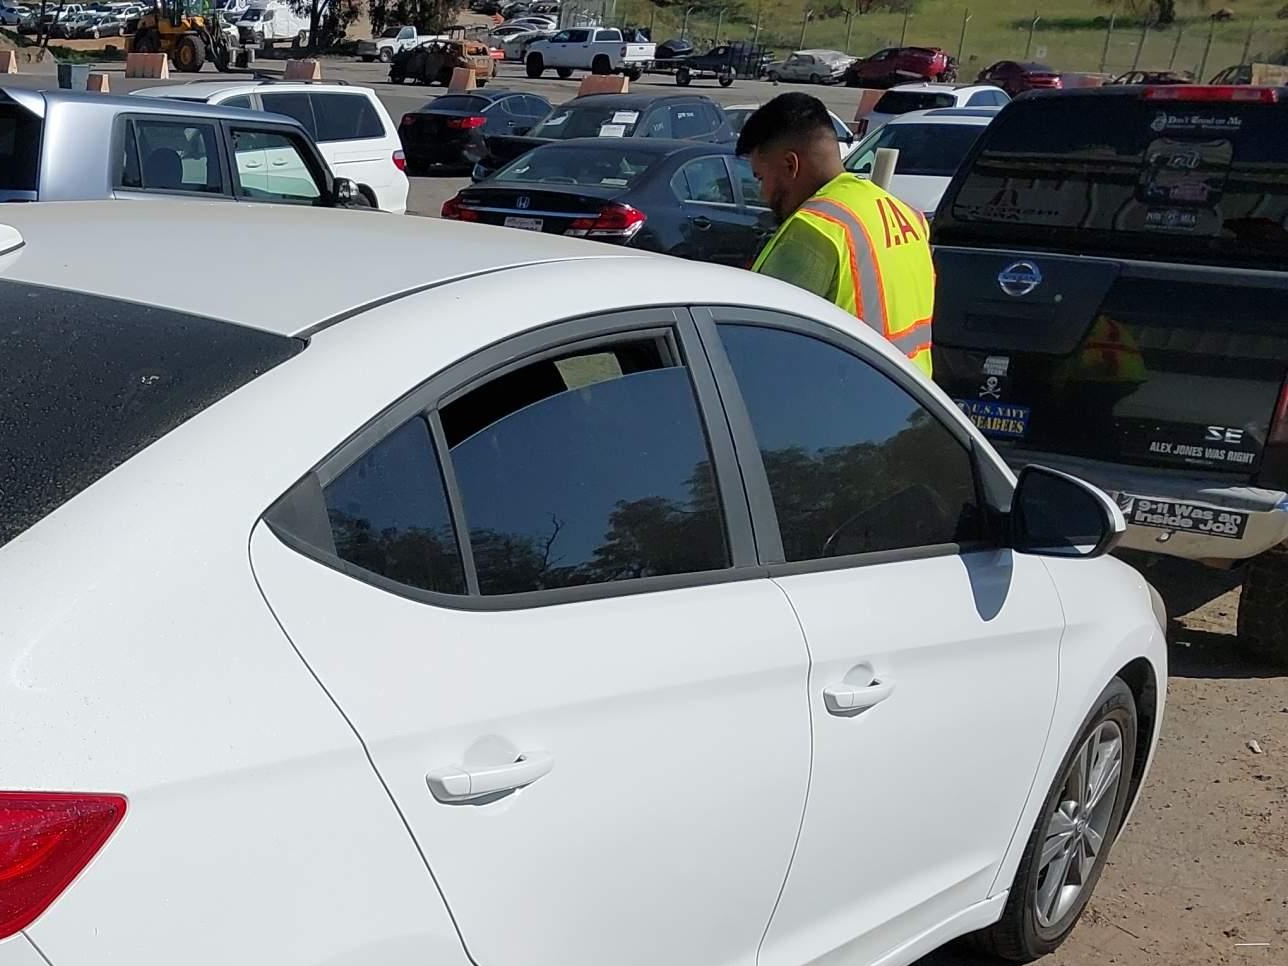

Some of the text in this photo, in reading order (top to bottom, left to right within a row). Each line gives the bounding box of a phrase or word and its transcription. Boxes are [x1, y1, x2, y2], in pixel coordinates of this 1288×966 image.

[996, 407, 1025, 419] NAVY
[970, 415, 1025, 434] SEABEES
[1205, 425, 1245, 444] SE
[1149, 442, 1173, 454] ALEX
[1173, 445, 1203, 457] JONES
[1205, 448, 1226, 460] WAS
[1227, 451, 1256, 465] RIGHT
[1134, 510, 1239, 535] Inside Job
[1138, 500, 1242, 527] 9-11 Was an
